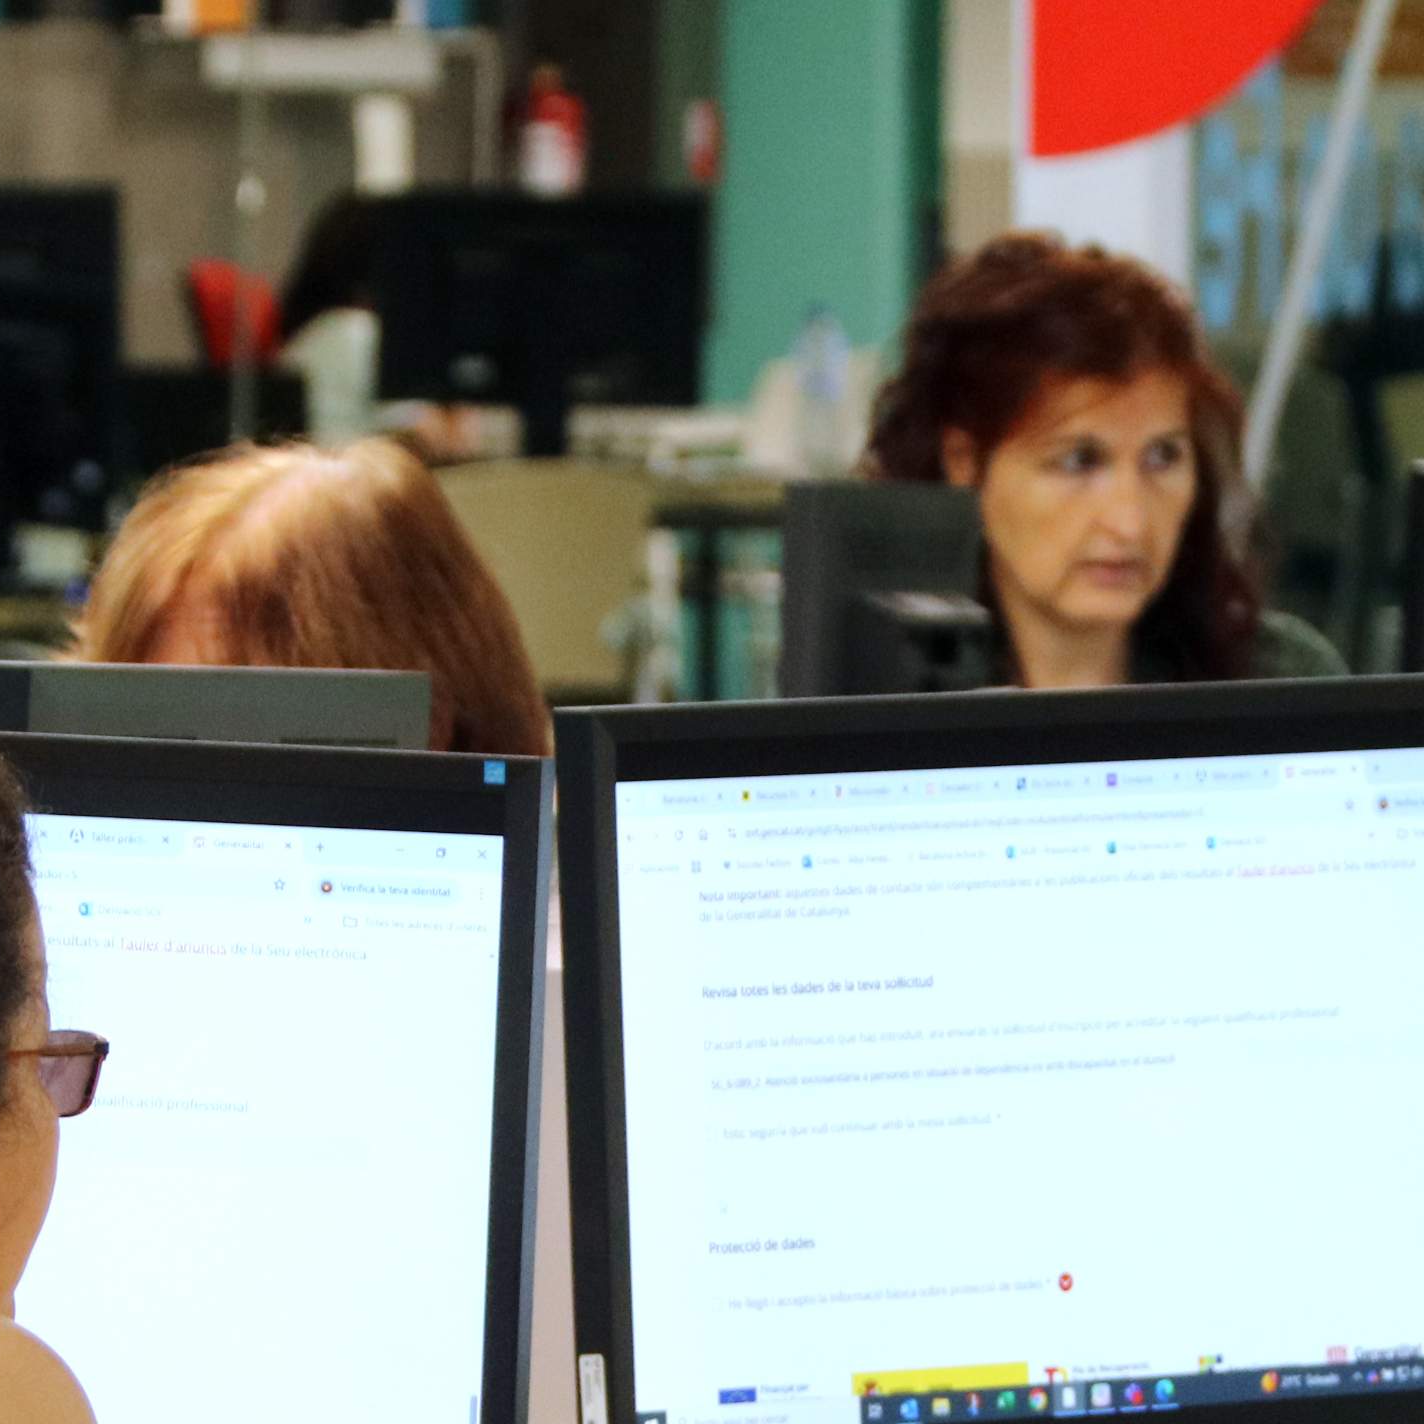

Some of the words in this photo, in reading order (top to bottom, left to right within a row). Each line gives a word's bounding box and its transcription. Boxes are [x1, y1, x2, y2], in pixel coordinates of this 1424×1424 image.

[340, 881, 376, 894] Verifica
[378, 883, 387, 894] la
[389, 885, 409, 896] teva
[411, 885, 451, 898] identitat
[120, 937, 161, 953] Tauler
[231, 942, 247, 956] de
[250, 943, 263, 957] la
[266, 944, 291, 959] Seu
[294, 945, 367, 962] electrònica
[702, 984, 738, 999] Revisa
[740, 983, 769, 998] totes
[772, 981, 788, 996] les
[790, 979, 825, 996] dades
[827, 978, 842, 993] de
[844, 978, 856, 992] la
[857, 977, 882, 992] teva
[709, 1236, 762, 1254] Protecció
[764, 1236, 779, 1251] de
[781, 1233, 816, 1250] dades
